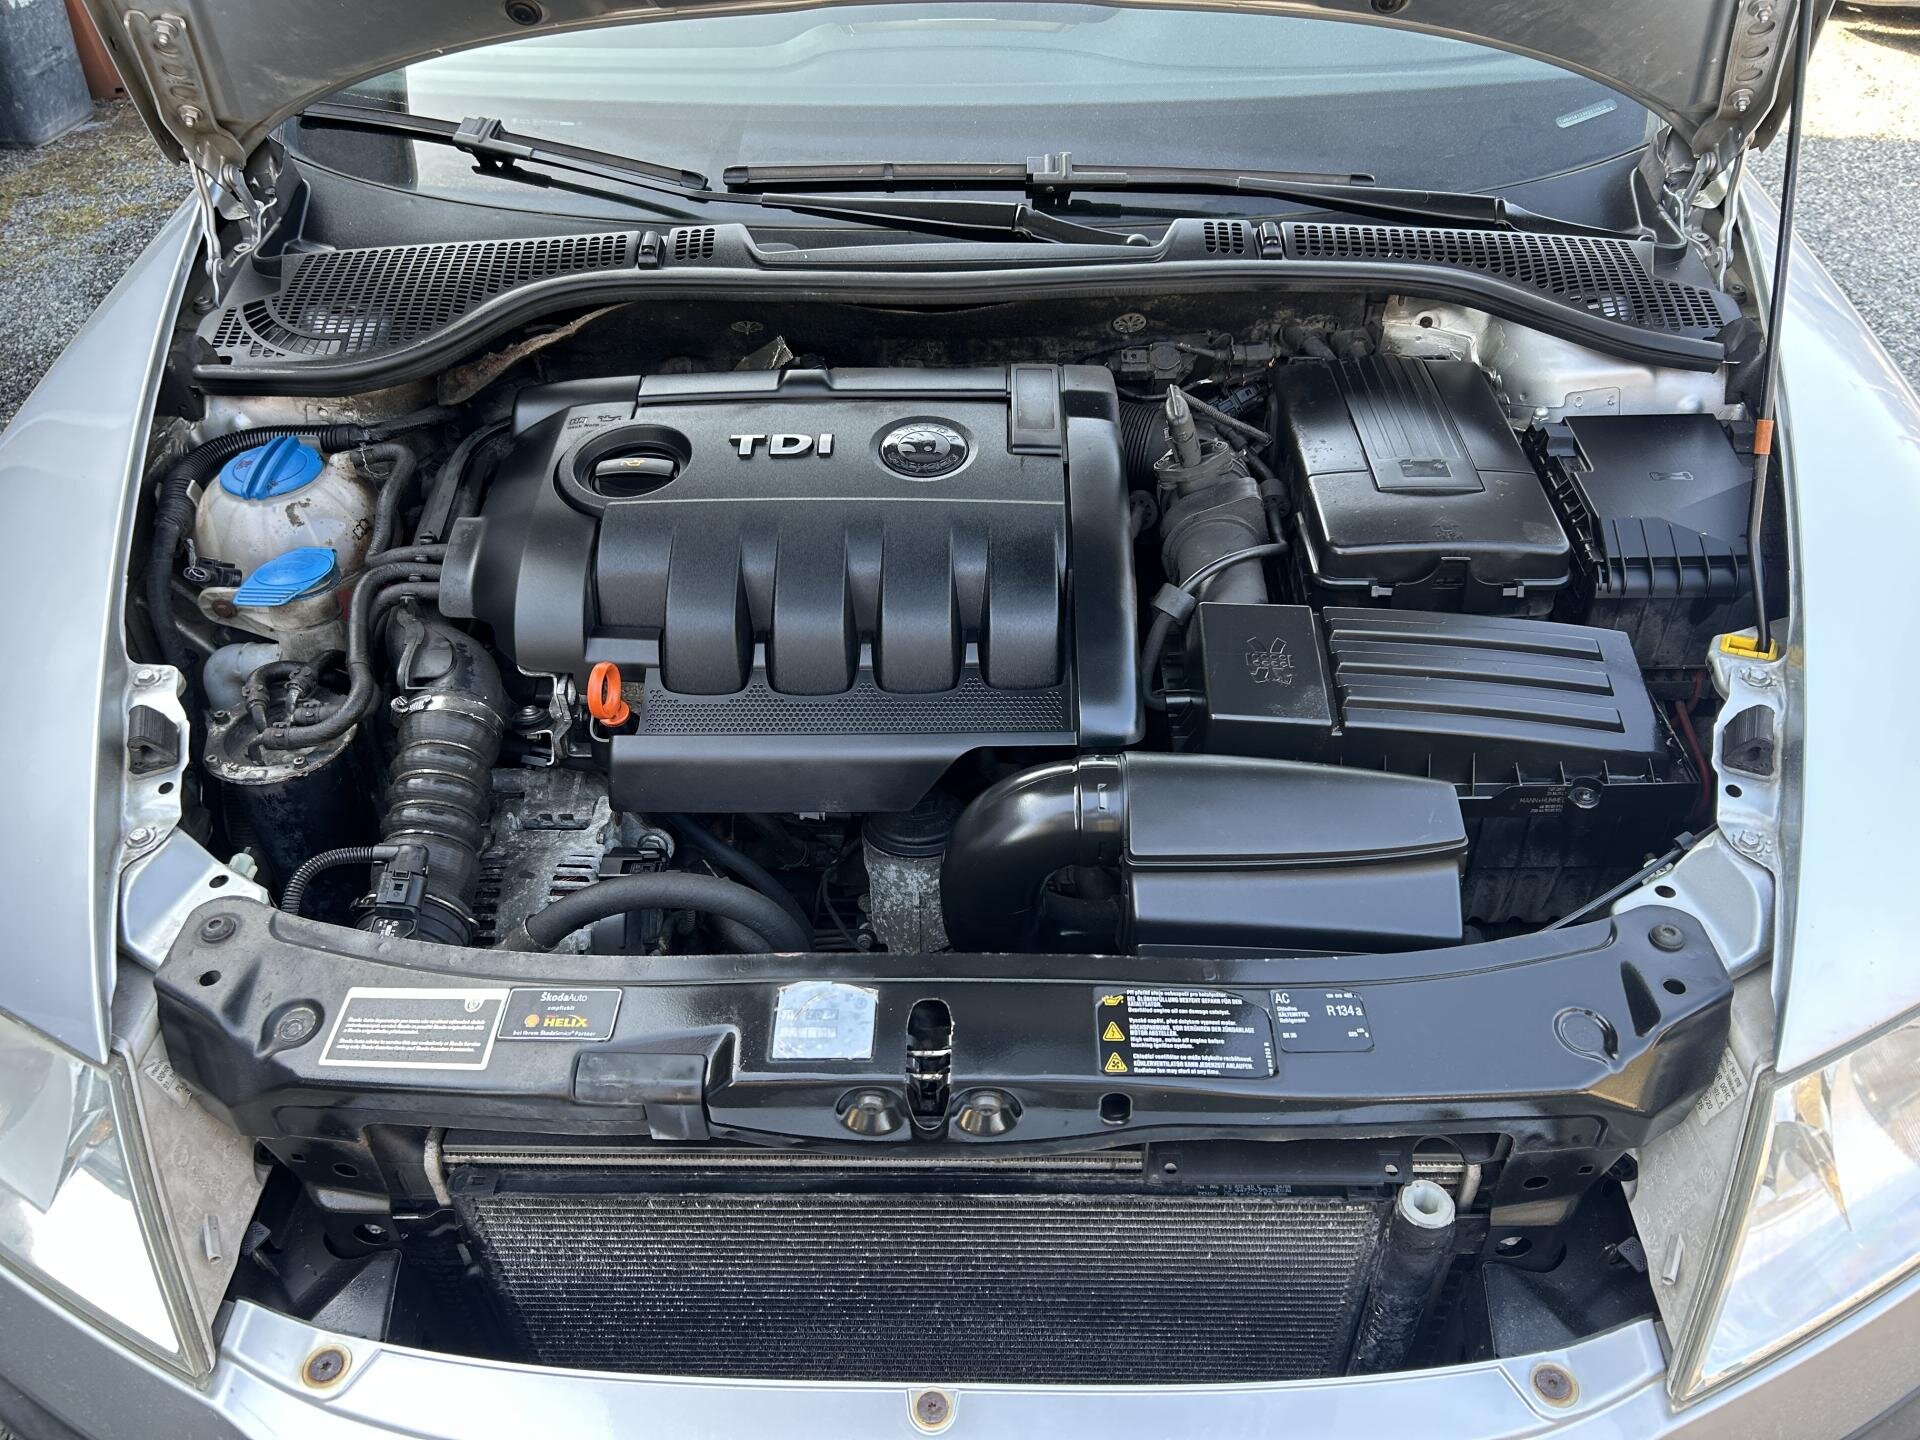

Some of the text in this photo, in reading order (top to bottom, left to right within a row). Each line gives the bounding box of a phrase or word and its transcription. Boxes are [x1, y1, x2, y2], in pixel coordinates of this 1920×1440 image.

[729, 433, 834, 459] TDI
[1275, 992, 1290, 1004] AC
[543, 1016, 589, 1028] HELIX
